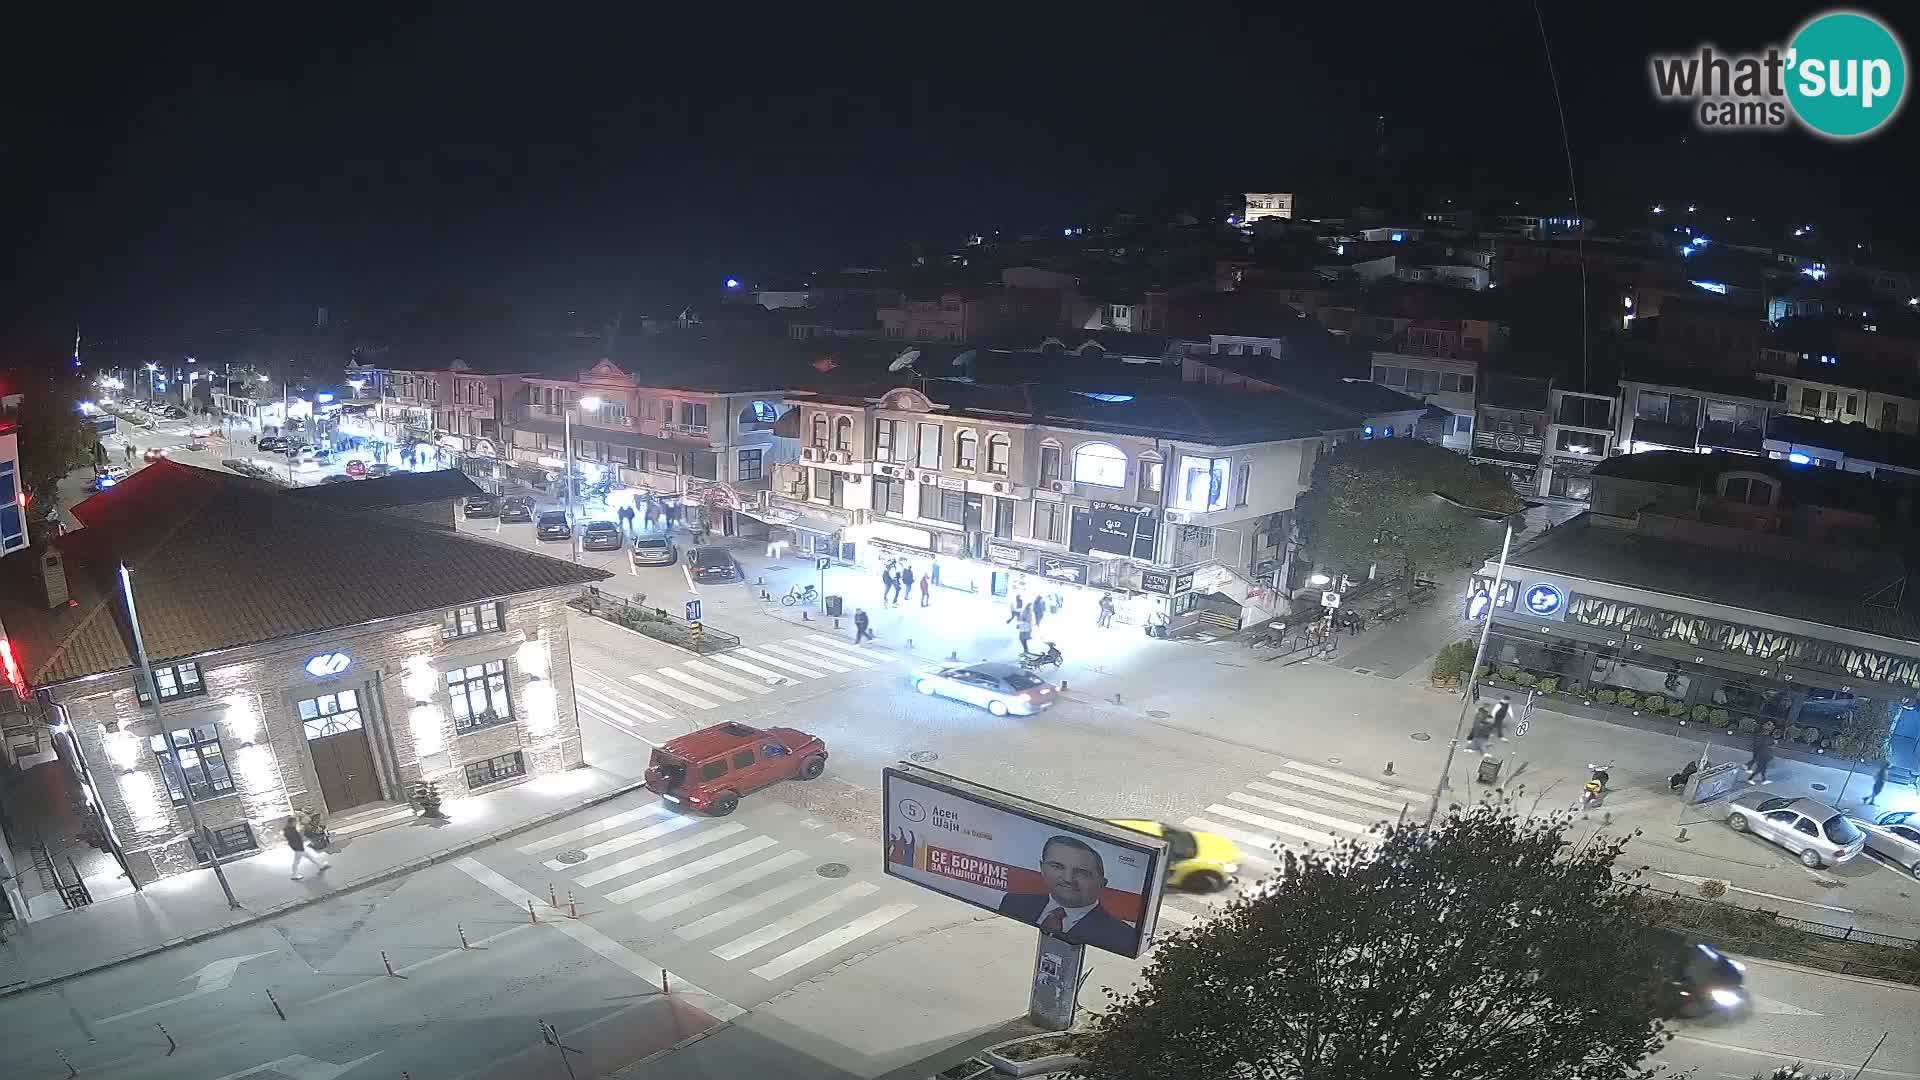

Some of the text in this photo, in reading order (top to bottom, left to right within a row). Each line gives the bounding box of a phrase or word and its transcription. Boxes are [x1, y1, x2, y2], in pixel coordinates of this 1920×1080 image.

[908, 804, 916, 817] 5
[932, 805, 958, 820] Асен
[931, 850, 1008, 880] СЕ БОРИМЕ
[931, 862, 942, 872] ЗА
